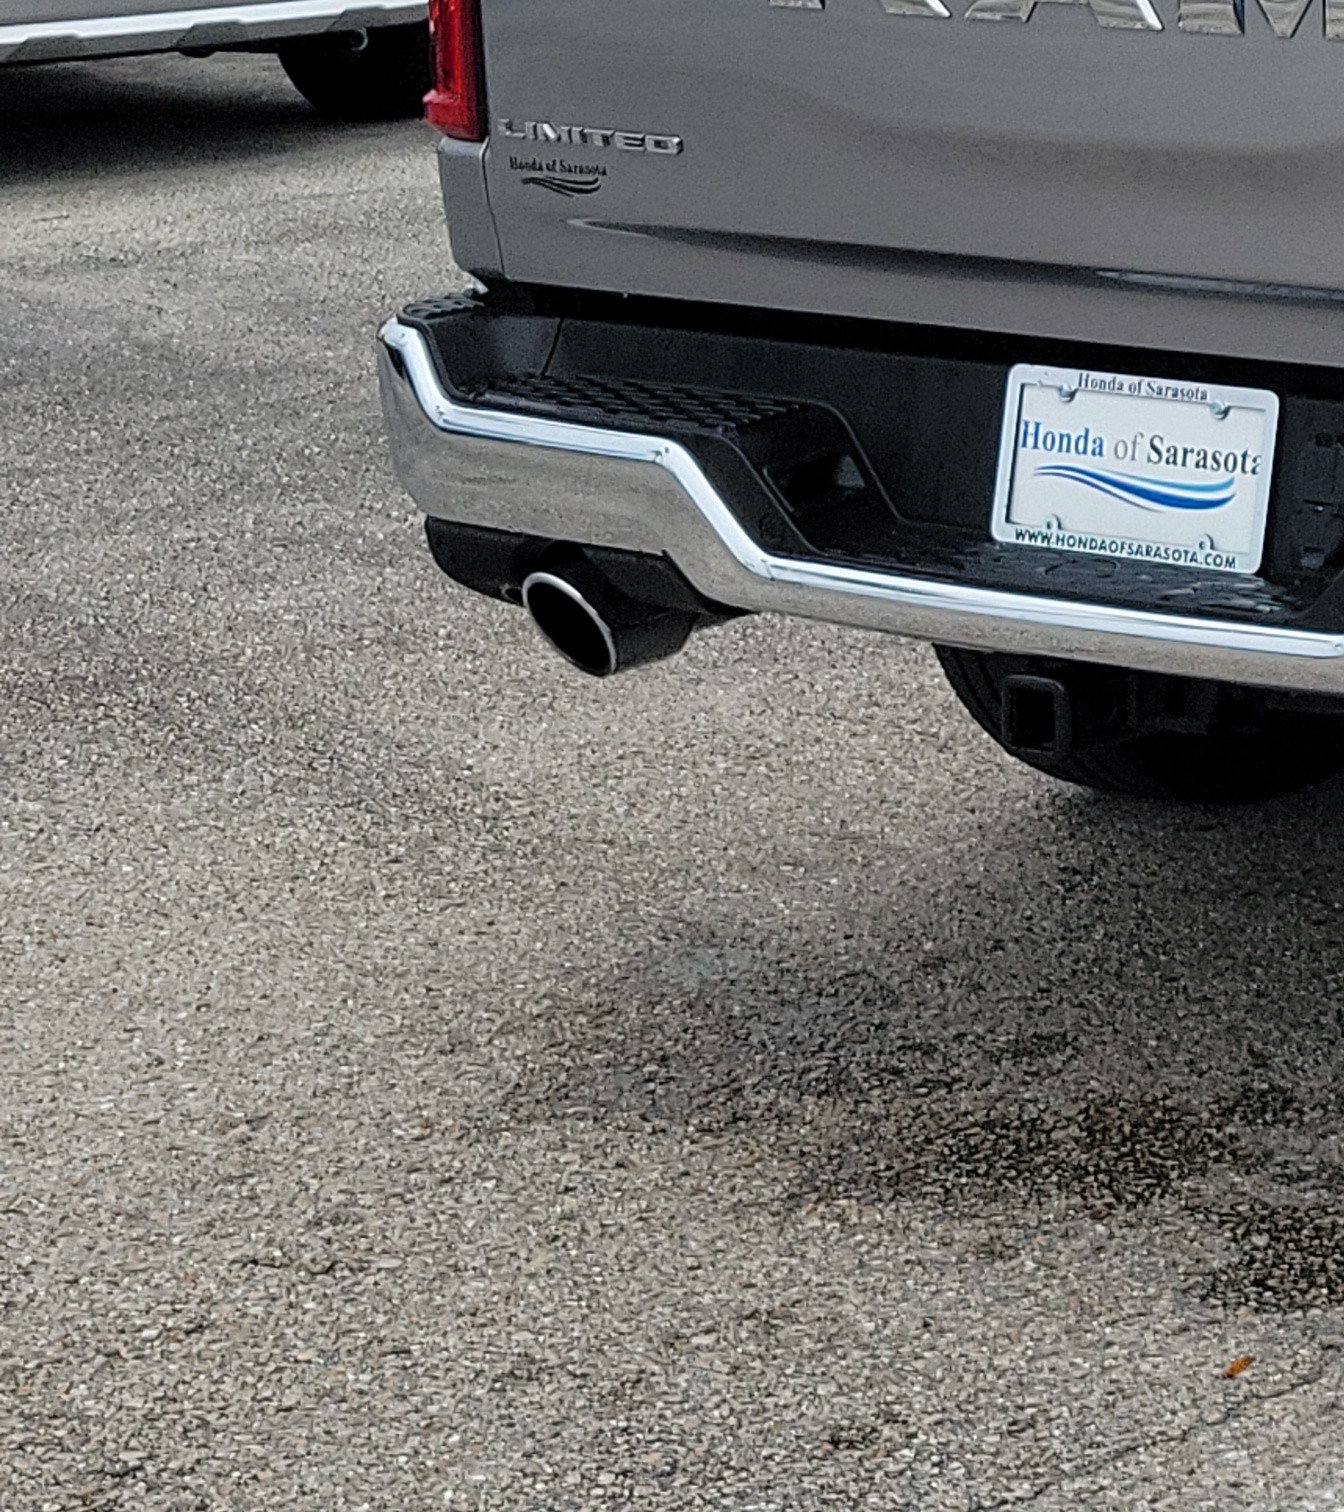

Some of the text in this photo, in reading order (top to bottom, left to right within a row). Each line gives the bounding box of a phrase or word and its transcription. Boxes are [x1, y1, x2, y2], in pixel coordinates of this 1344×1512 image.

[500, 118, 684, 156] LIMITED
[509, 155, 607, 177] Honda of Sarasota
[1077, 372, 1208, 402] Honda of Sarasota
[1020, 419, 1262, 476] Honda of Sarasota
[1014, 527, 1237, 570] WWW.HONDAOFSARASOTA.COM
